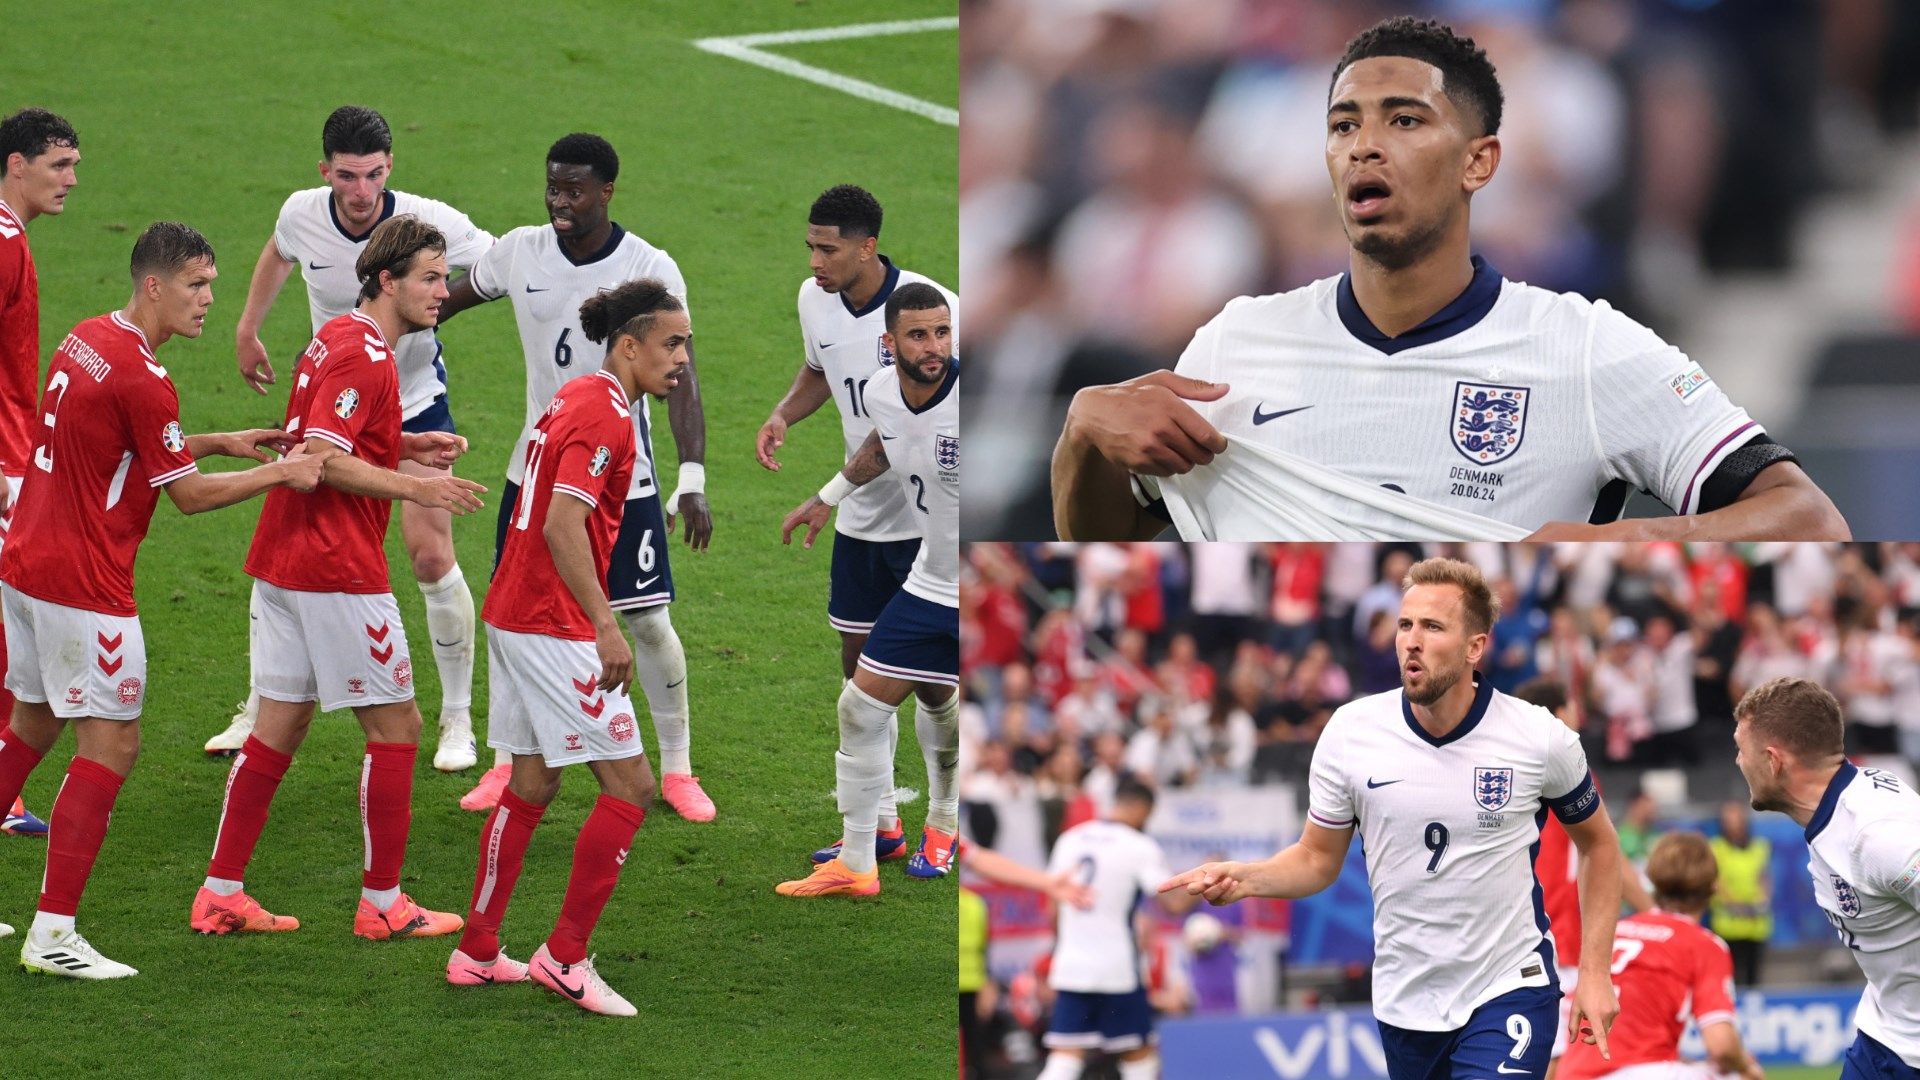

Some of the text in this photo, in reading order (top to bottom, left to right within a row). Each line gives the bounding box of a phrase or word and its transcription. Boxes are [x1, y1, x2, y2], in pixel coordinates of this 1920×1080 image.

[554, 327, 574, 370] 6
[909, 474, 930, 515] 2
[1449, 466, 1504, 487] DENMARK
[1450, 482, 1495, 502] 20.06.24
[637, 529, 656, 573] 6
[1424, 821, 1451, 874] 9
[1505, 1013, 1533, 1061] 9
